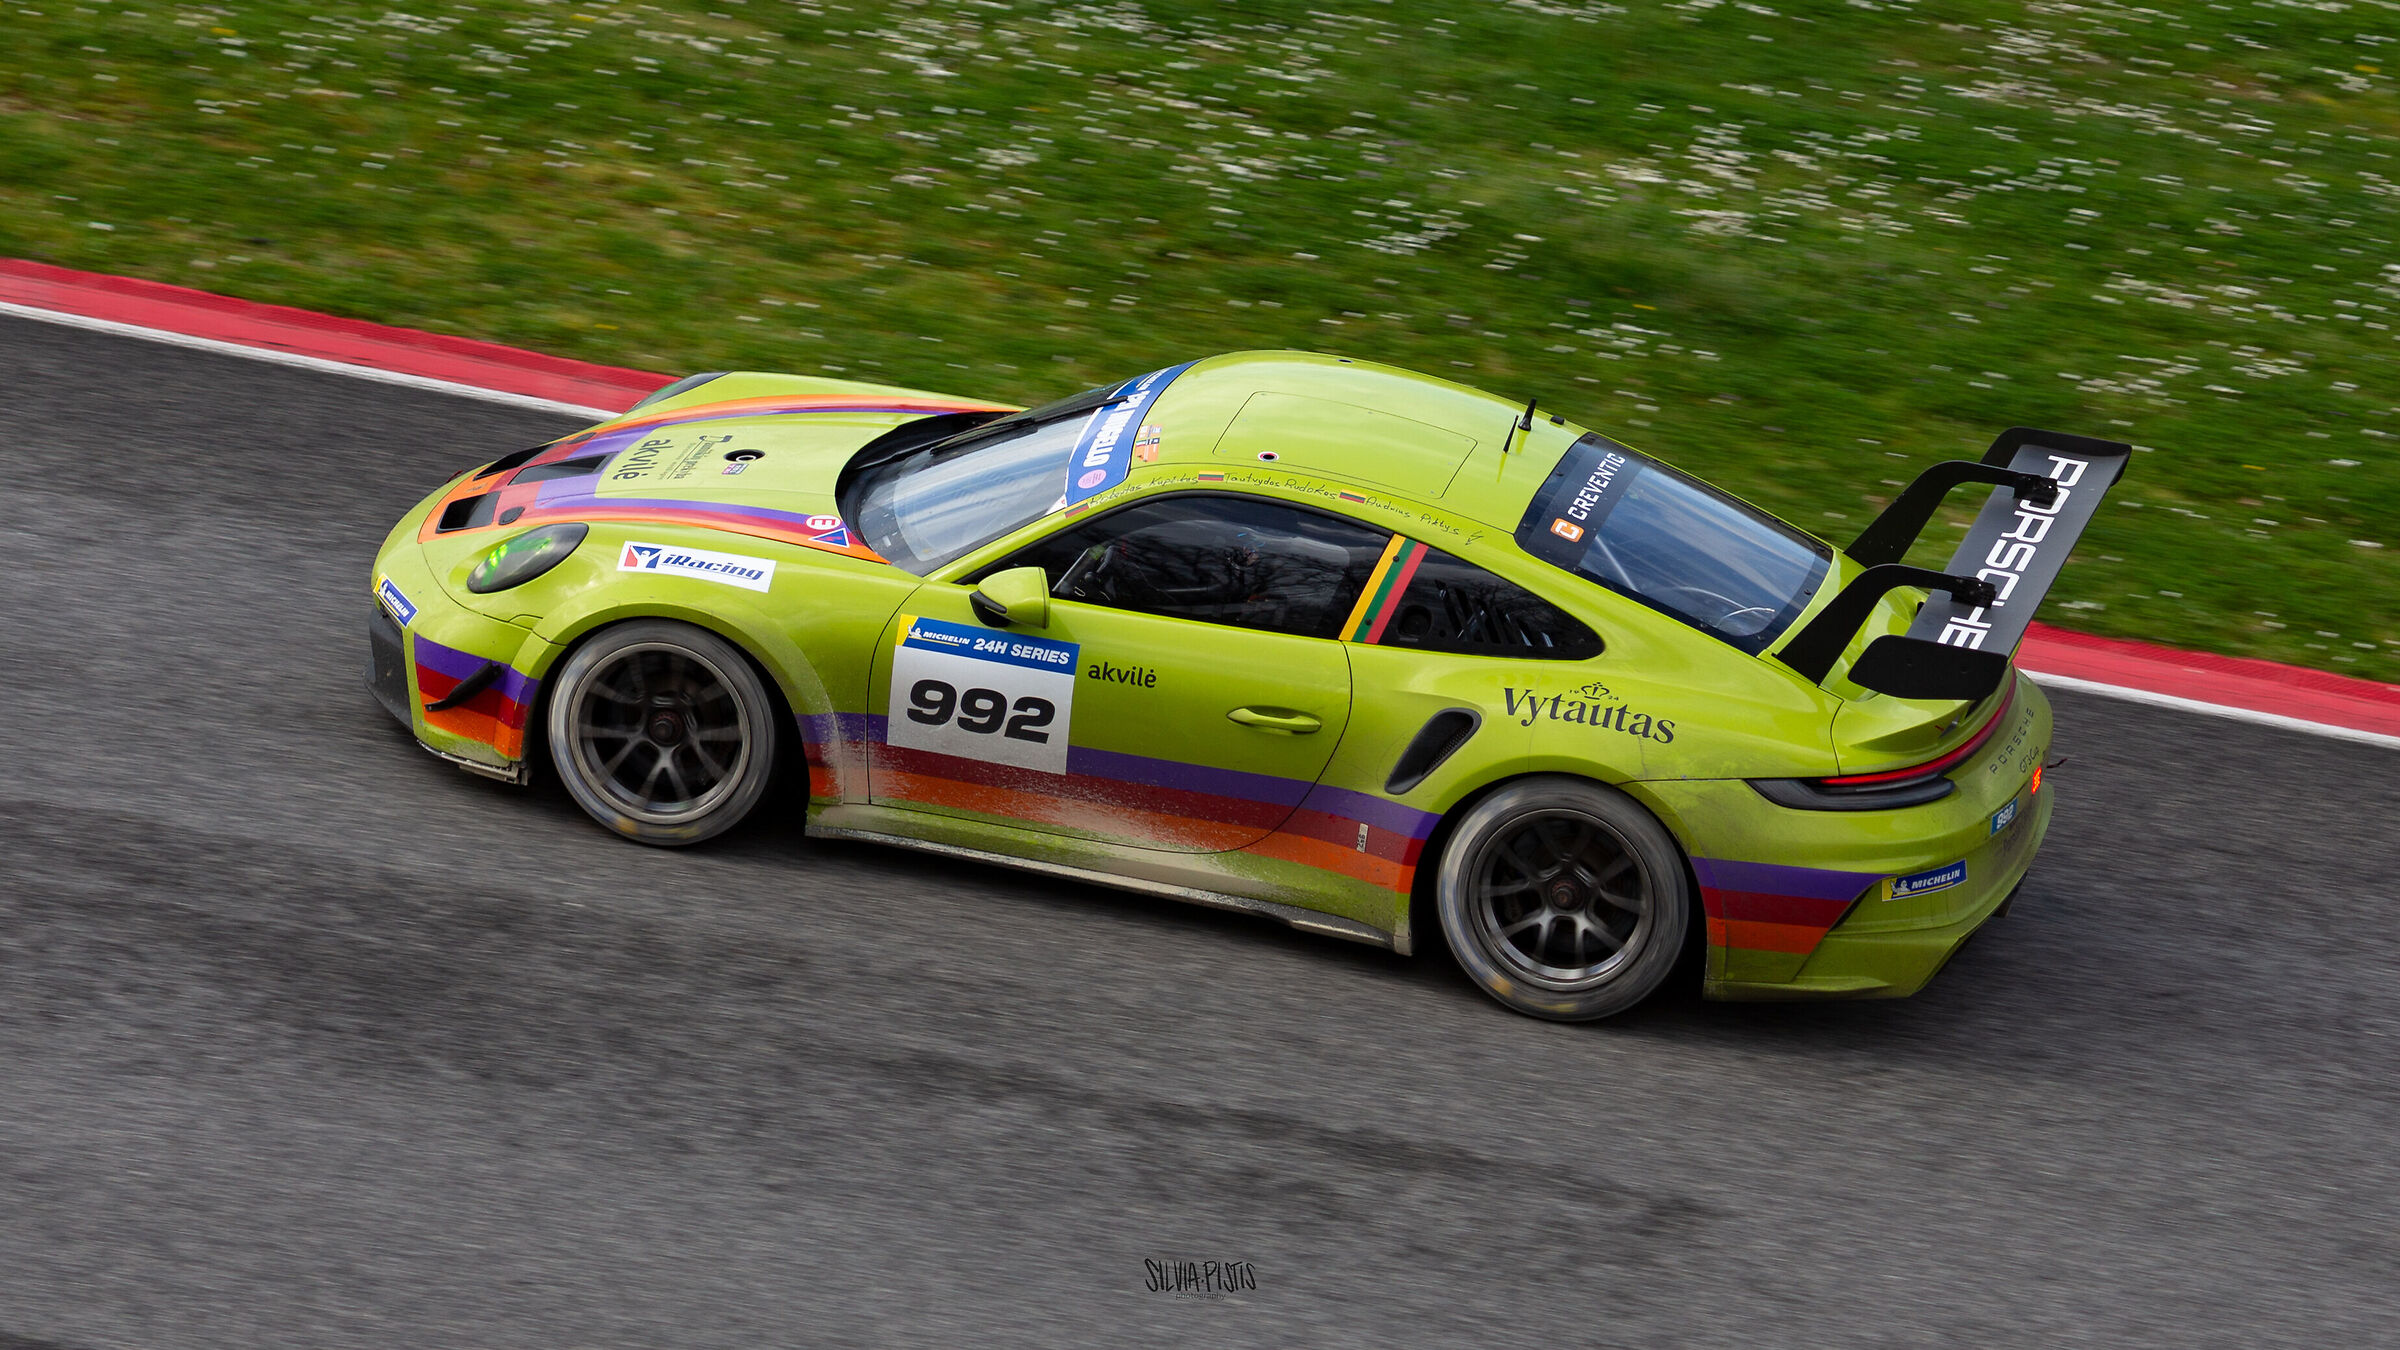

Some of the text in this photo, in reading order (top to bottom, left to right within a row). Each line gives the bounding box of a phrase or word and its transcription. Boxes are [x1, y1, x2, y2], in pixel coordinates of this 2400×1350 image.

[612, 439, 673, 480] akvilė
[1567, 452, 1625, 520] CREVENTIC
[663, 554, 765, 581] iRacing
[1937, 455, 2089, 650] PORSCHE
[923, 631, 1070, 665] MICHELIN 24H SERIES
[1088, 661, 1157, 688] akvilė
[906, 679, 1056, 744] 992
[1504, 687, 1676, 744] Vytautas
[1989, 707, 2034, 775] PORSCHE
[1996, 804, 2015, 830] 992
[1911, 869, 1961, 889] MICHELIN
